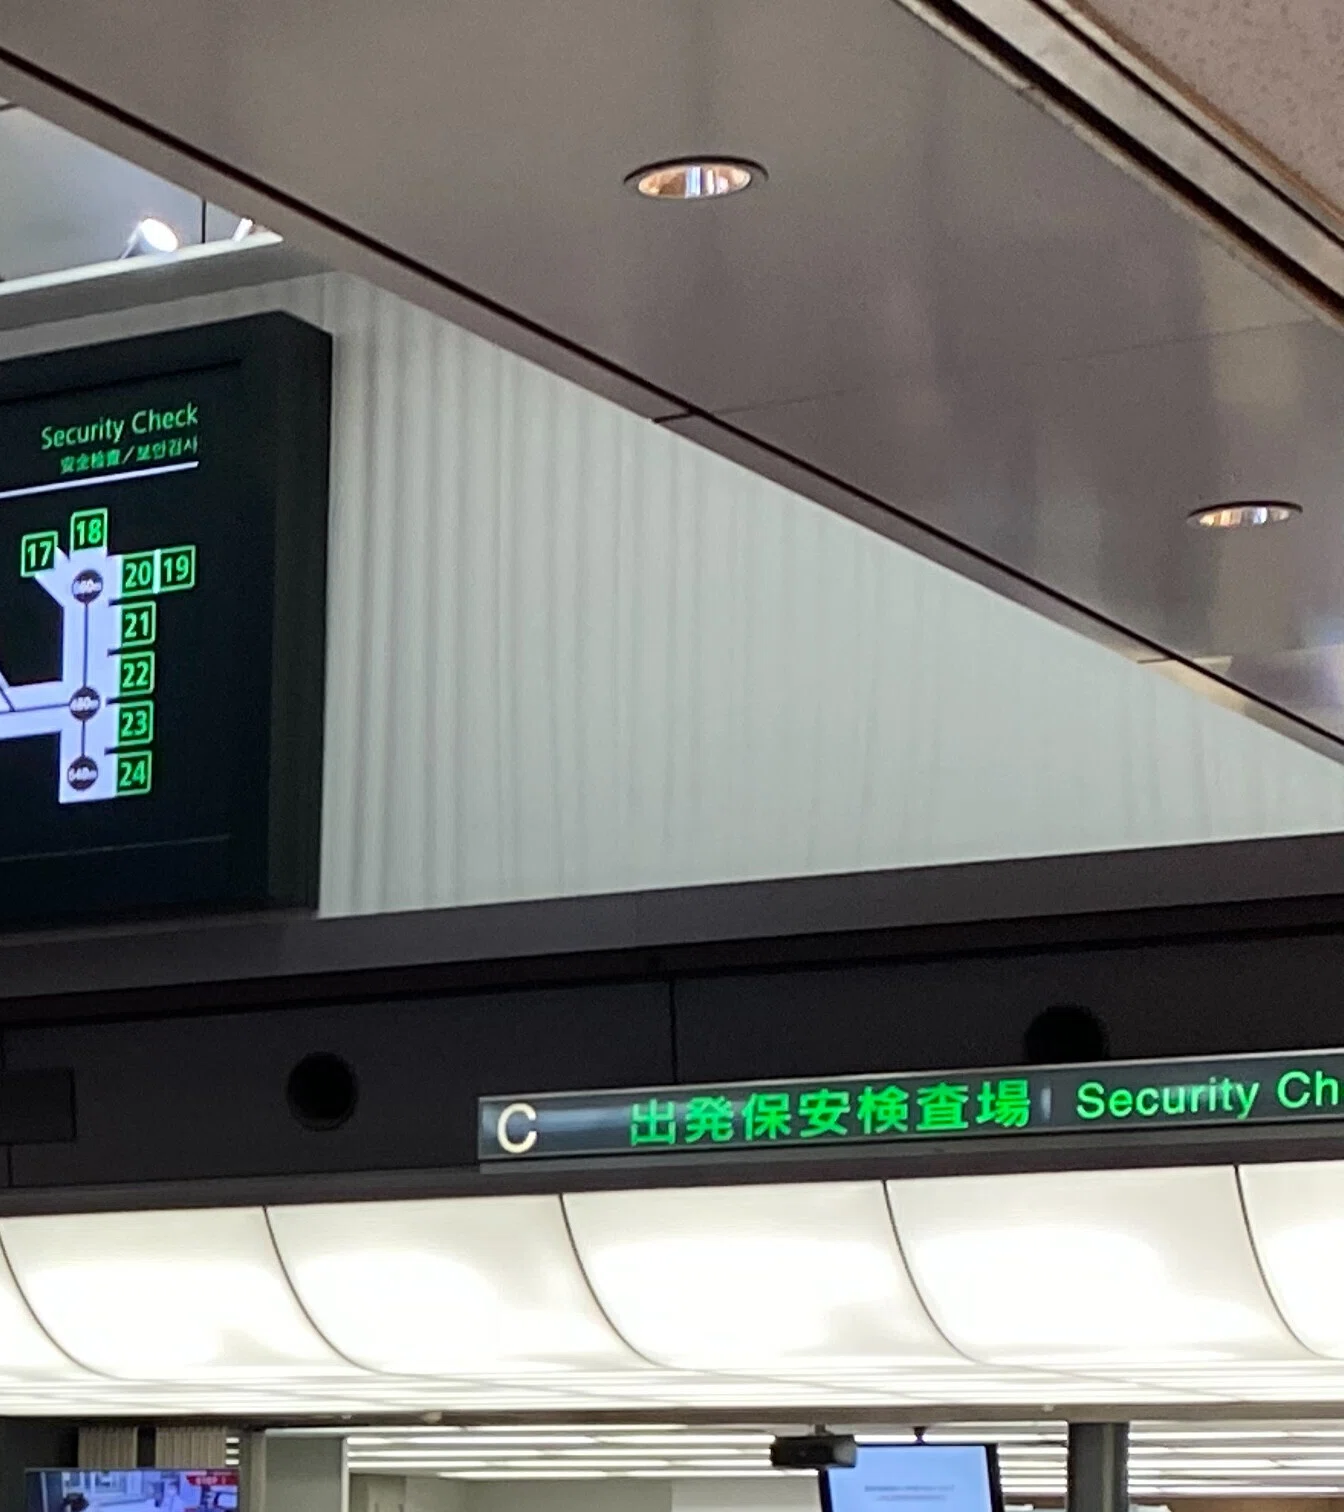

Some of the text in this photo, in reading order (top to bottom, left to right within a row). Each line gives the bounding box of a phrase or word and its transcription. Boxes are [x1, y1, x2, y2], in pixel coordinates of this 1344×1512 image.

[41, 402, 198, 450] Security Check
[76, 517, 102, 546] 18
[27, 540, 53, 569] 17
[163, 554, 190, 583] 19
[124, 560, 152, 588] 20
[124, 610, 150, 638] 21
[121, 660, 150, 688] 22
[121, 710, 147, 737] 23
[119, 759, 146, 787] 24
[496, 1069, 1343, 1155] C 出発保安検査場 Security Ch
